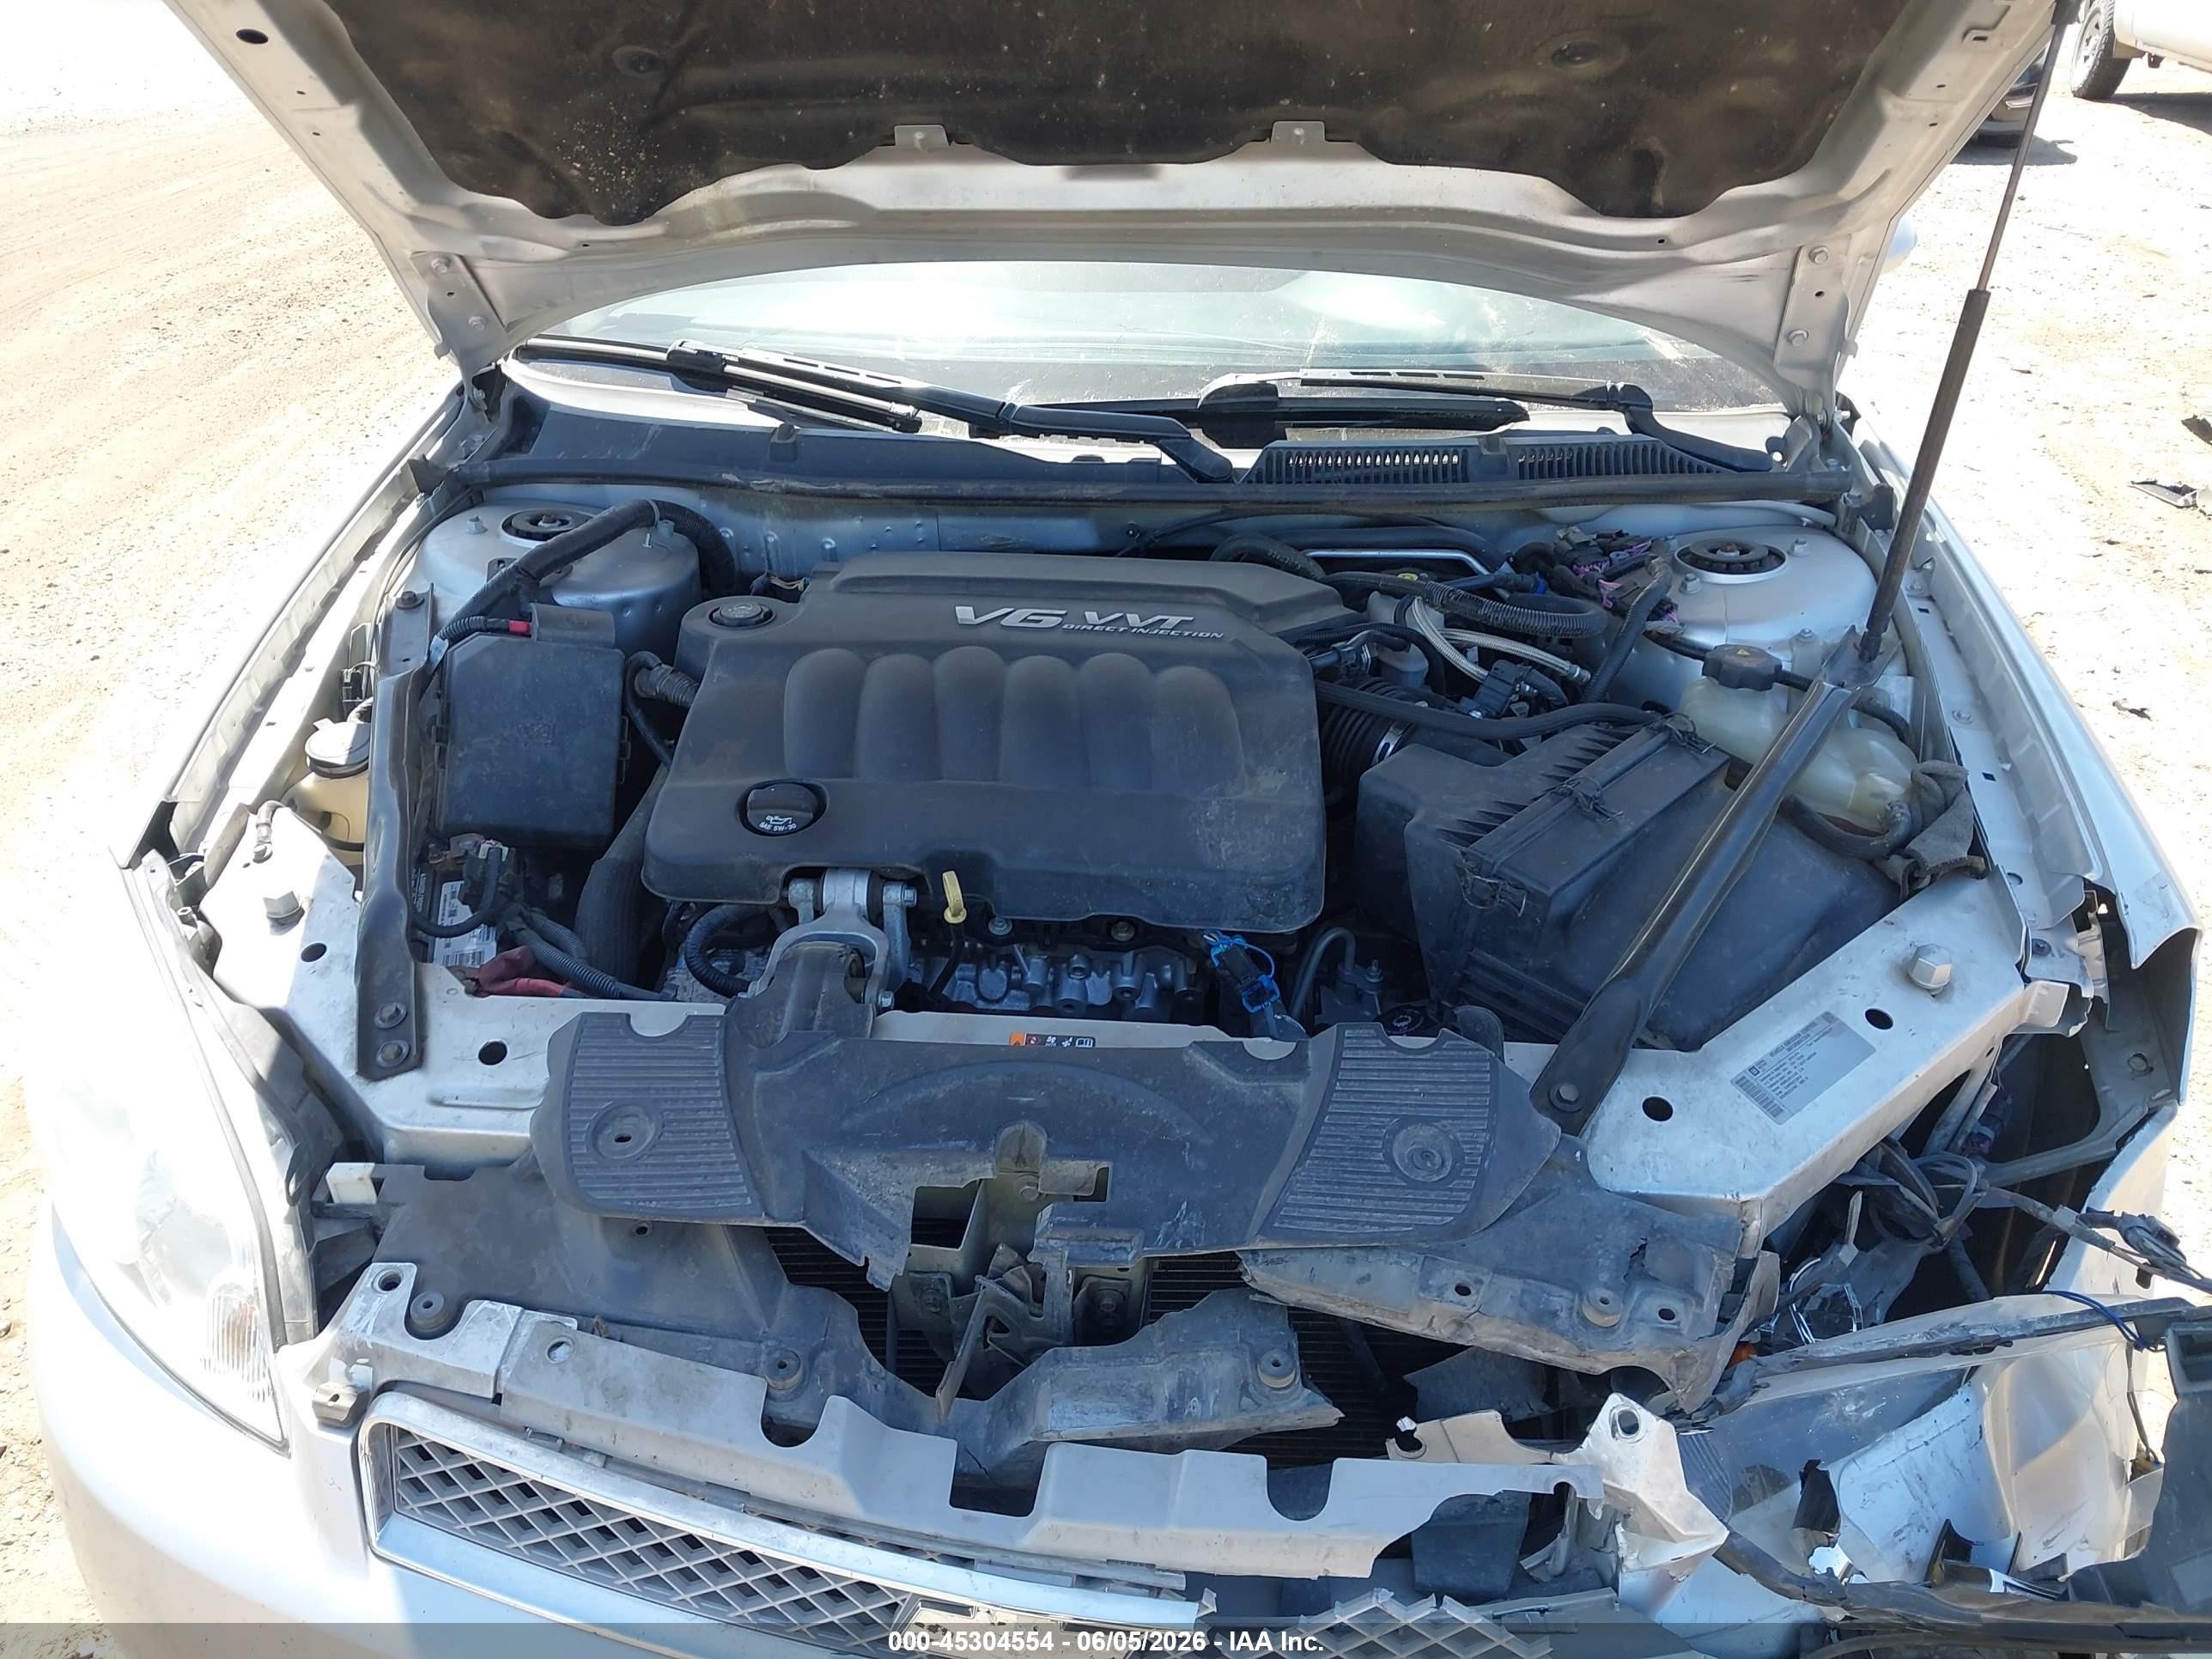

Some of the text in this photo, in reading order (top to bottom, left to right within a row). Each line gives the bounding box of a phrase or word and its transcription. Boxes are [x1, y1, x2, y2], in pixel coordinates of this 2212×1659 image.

[955, 605, 1194, 629] V6 VVT
[1062, 623, 1224, 639] DIRECT INJECTION
[758, 821, 772, 830] SAE
